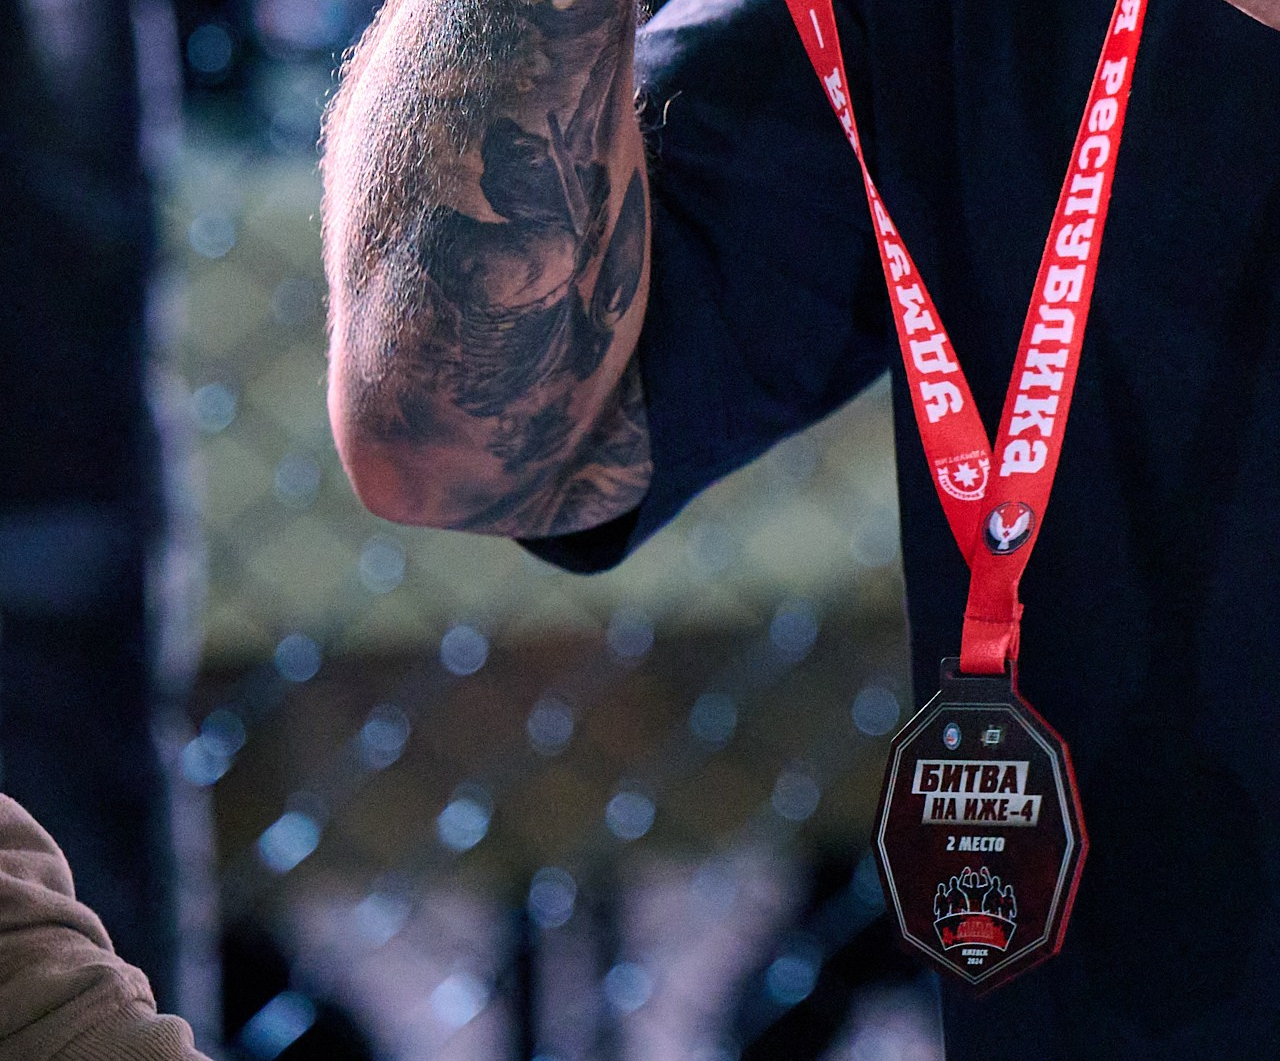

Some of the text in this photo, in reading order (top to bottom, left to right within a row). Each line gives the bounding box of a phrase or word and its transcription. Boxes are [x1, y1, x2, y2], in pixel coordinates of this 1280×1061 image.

[919, 763, 1019, 793] БИТВА
[930, 797, 1034, 822] НА ИЖЕ-4
[946, 836, 1006, 852] 2 МЕСТО
